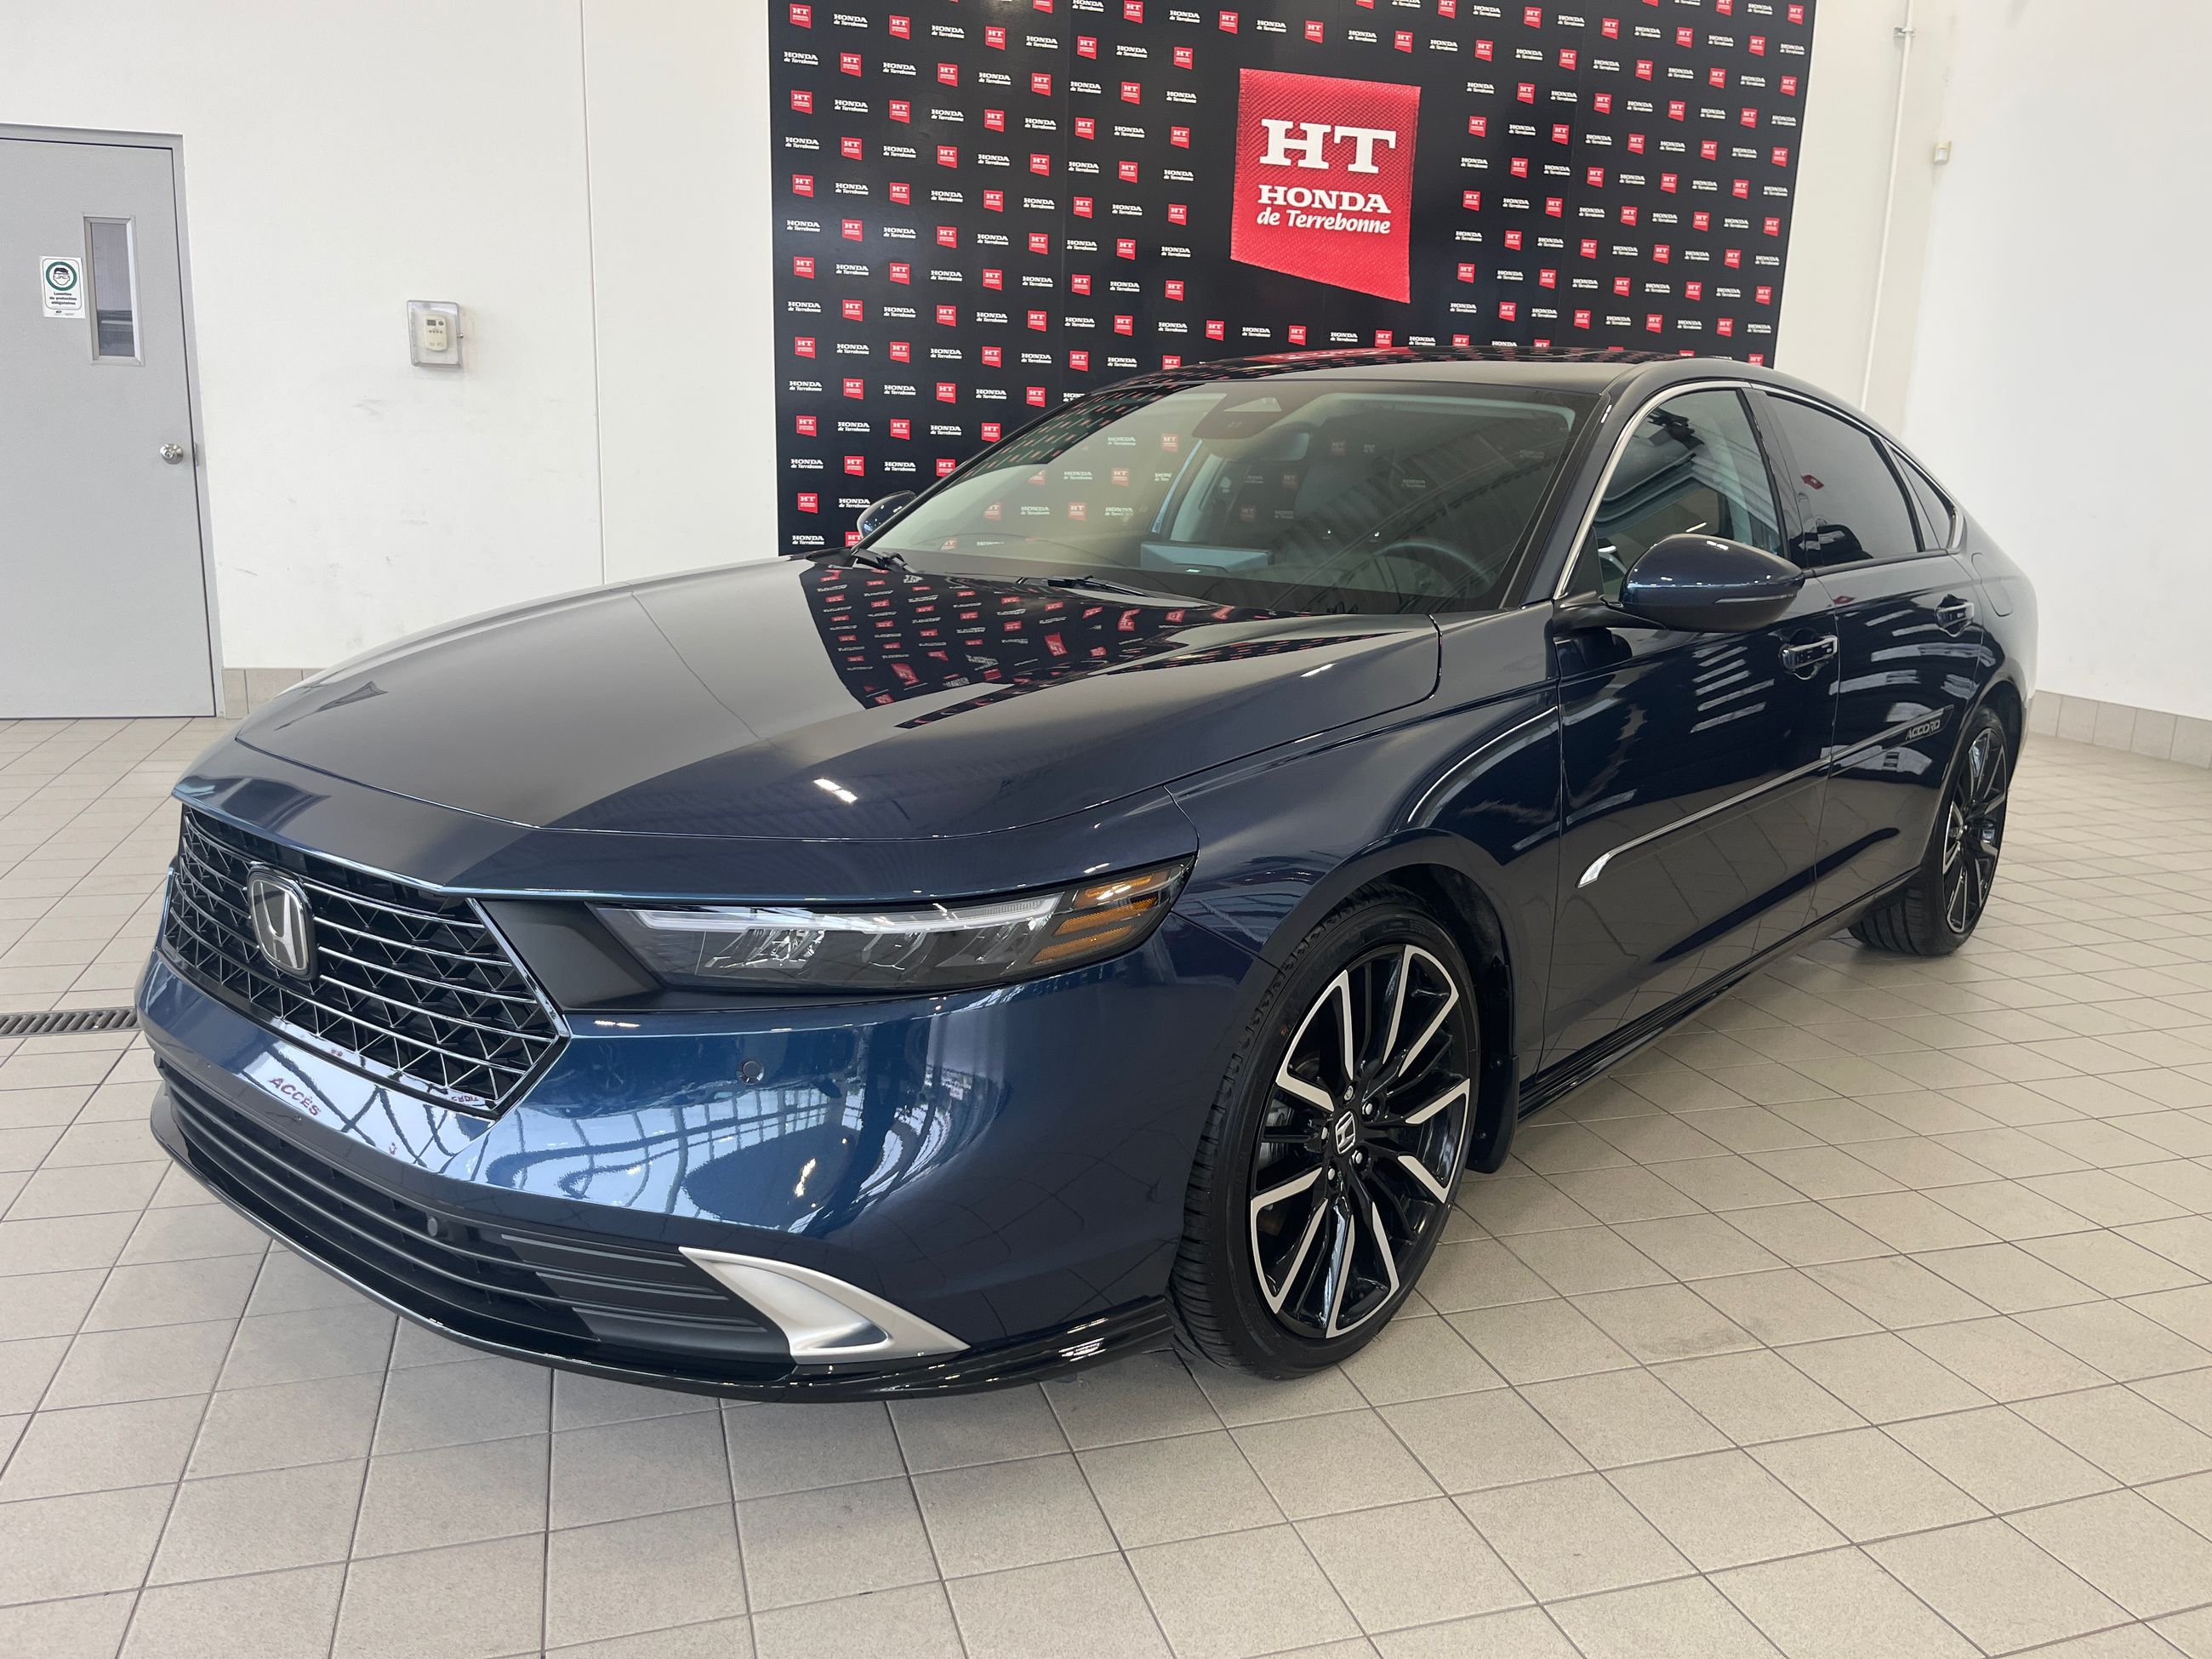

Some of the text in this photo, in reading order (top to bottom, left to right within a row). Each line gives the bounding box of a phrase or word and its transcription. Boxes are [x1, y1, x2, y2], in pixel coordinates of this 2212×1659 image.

[834, 14, 868, 22] HONDA
[1170, 10, 1200, 19] HONDA
[932, 26, 964, 34] HONDA
[883, 62, 915, 71] HONDA
[1259, 119, 1396, 174] HT
[1257, 185, 1391, 214] HONDA
[1257, 207, 1391, 234] de Terrebonne
[1905, 719, 1941, 741] ACCORD
[268, 1077, 322, 1116] ACCÈS
